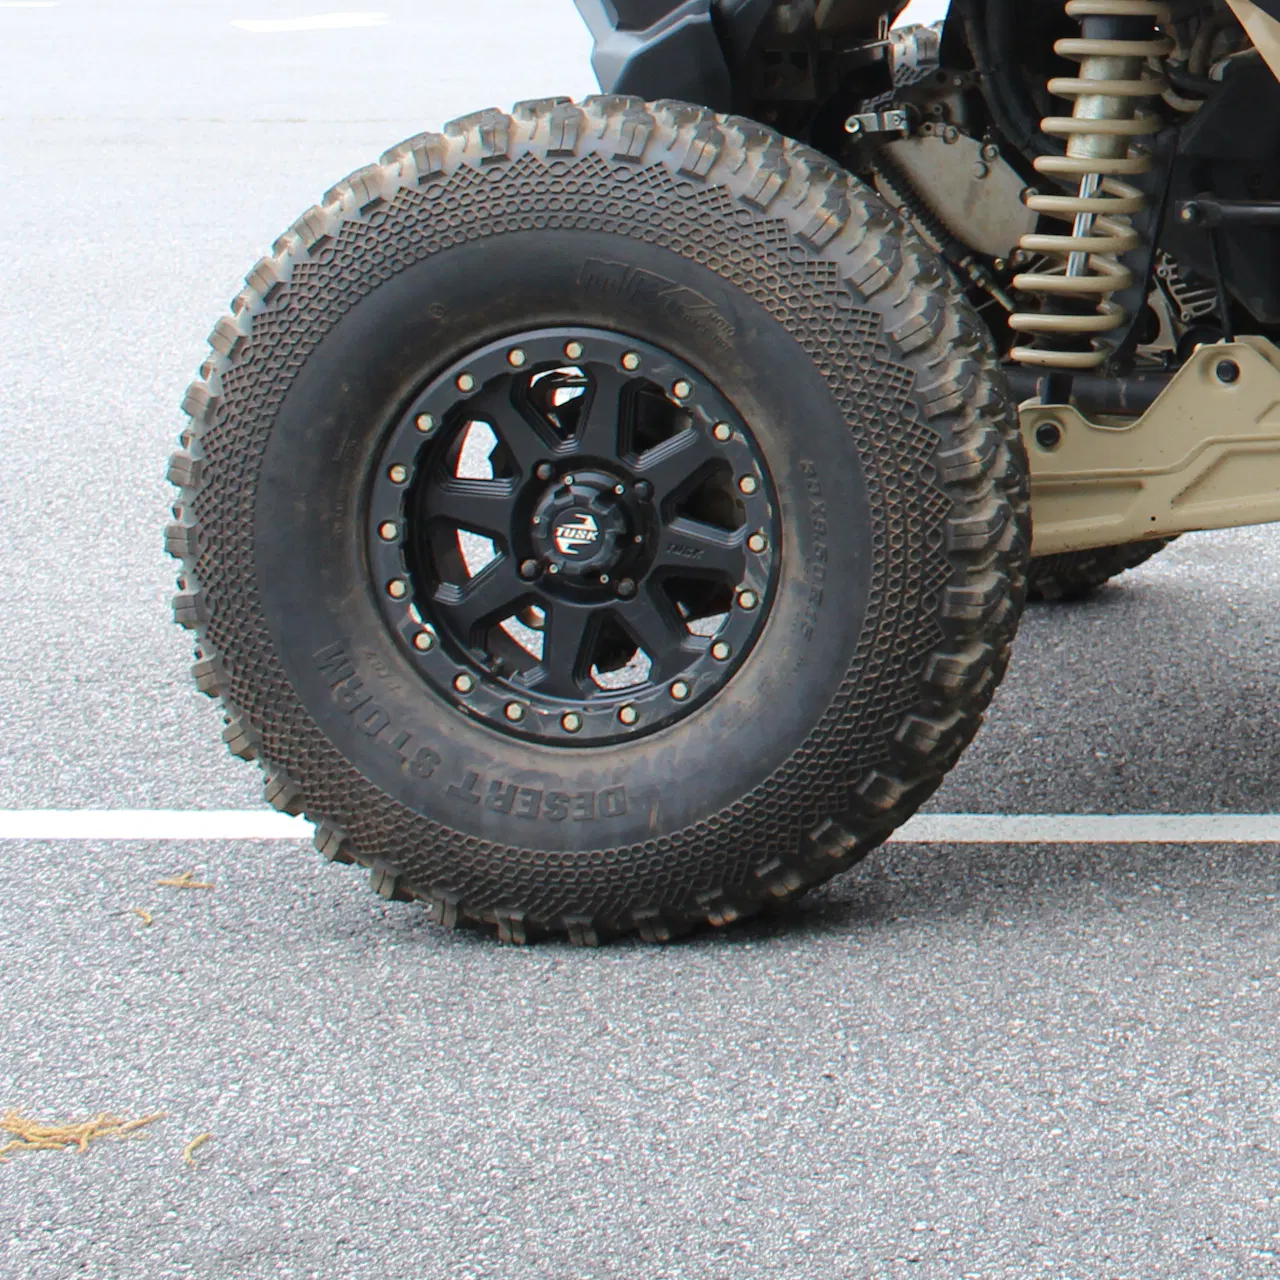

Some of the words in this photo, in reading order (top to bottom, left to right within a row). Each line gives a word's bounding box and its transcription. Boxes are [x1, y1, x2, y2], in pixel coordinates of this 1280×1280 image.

[555, 526, 600, 541] TUSK
[312, 638, 442, 778] STORM
[447, 771, 629, 820] DESERT
